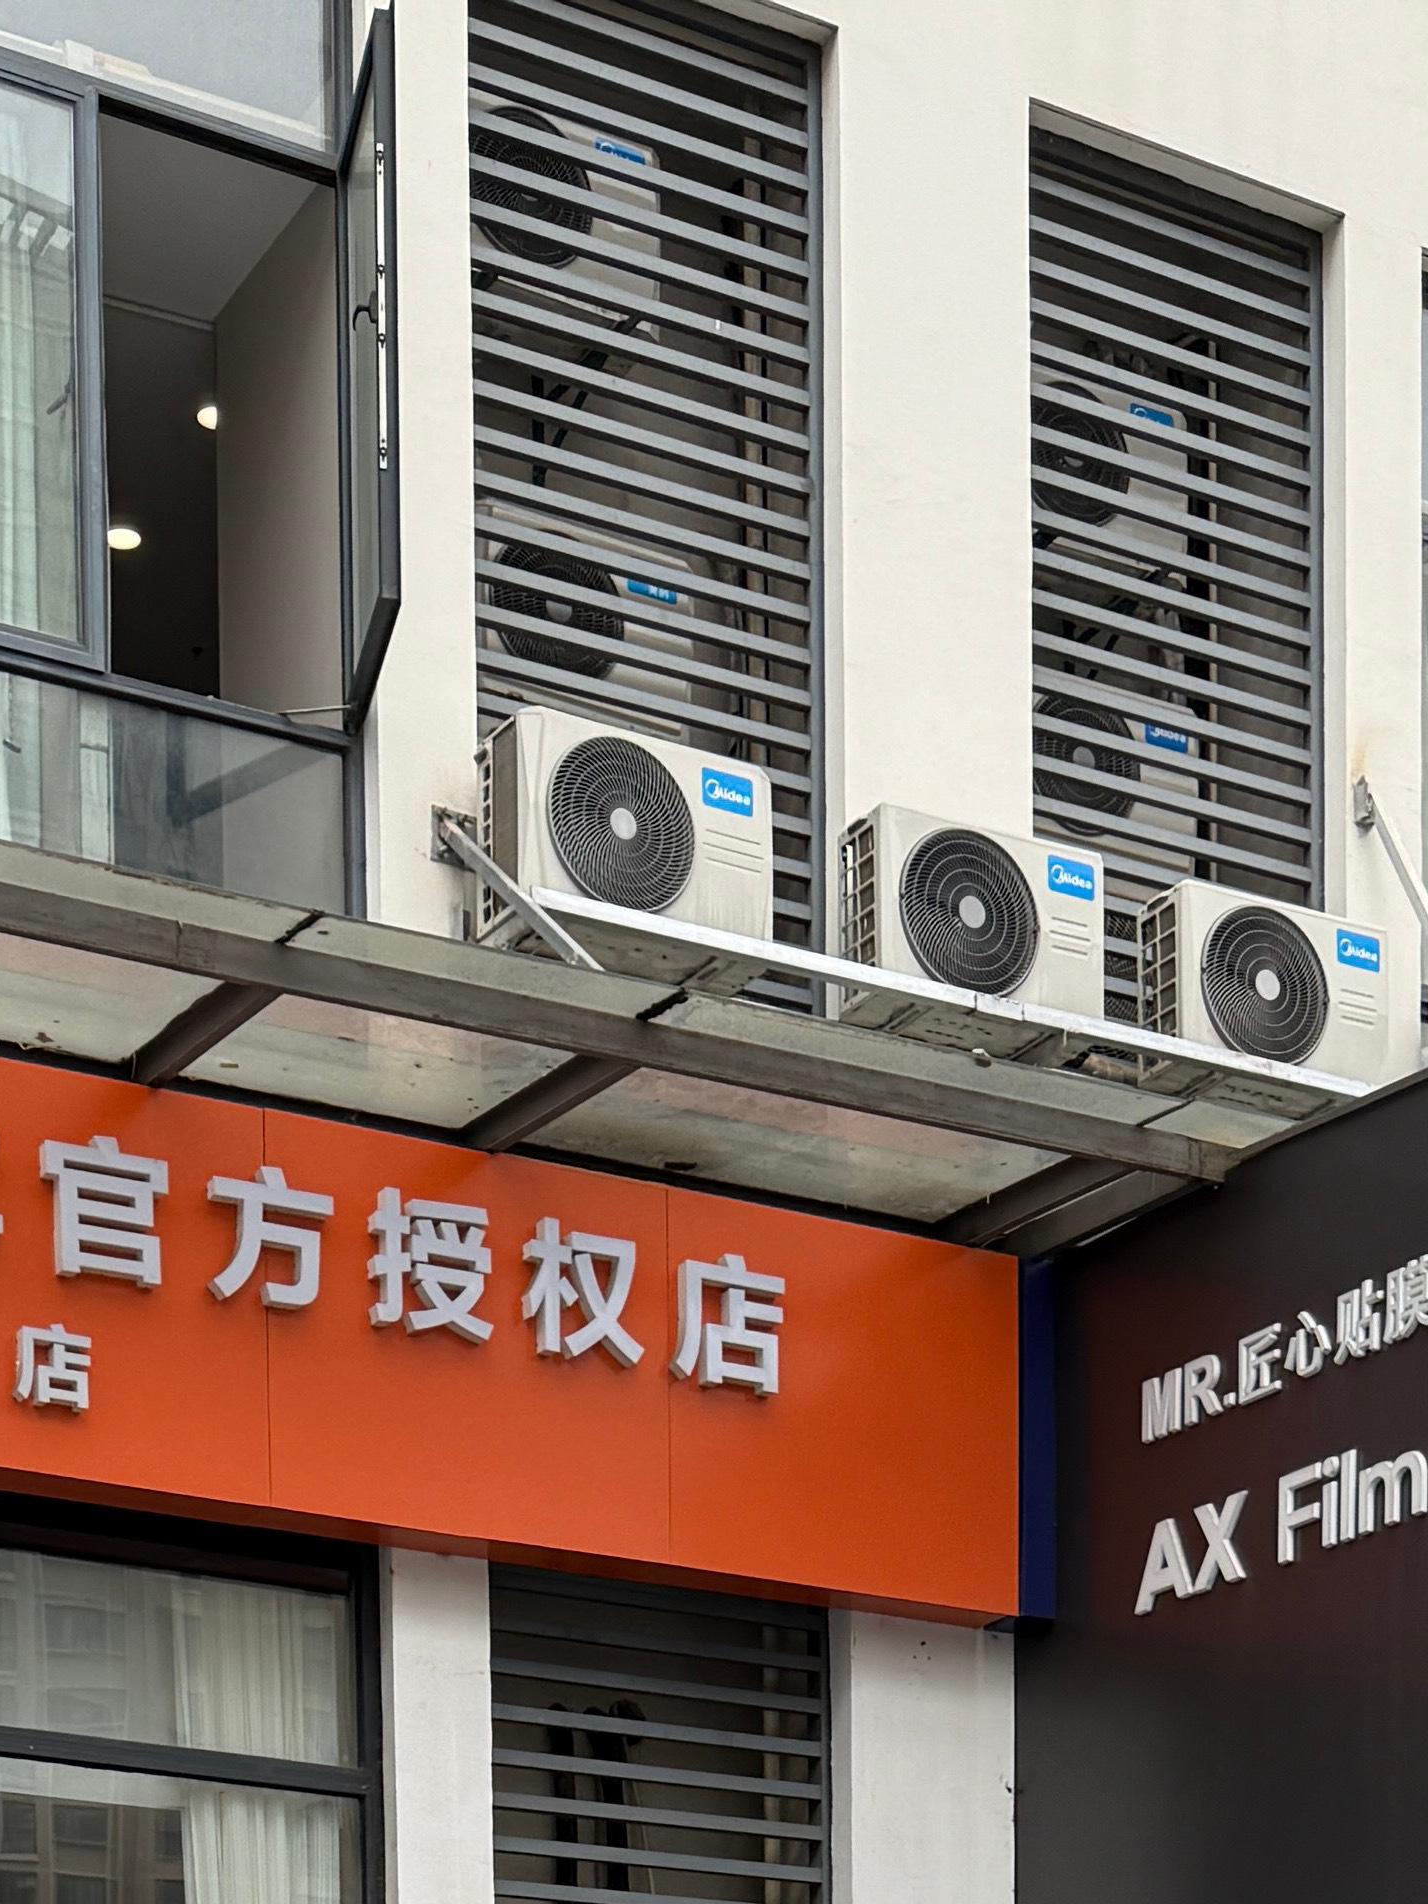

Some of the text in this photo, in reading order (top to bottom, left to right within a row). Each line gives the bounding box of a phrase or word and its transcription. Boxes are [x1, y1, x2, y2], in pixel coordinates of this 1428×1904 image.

[705, 778, 751, 806] Midea
[1051, 864, 1093, 890] Midea
[1134, 1448, 1428, 1616] AX Film
